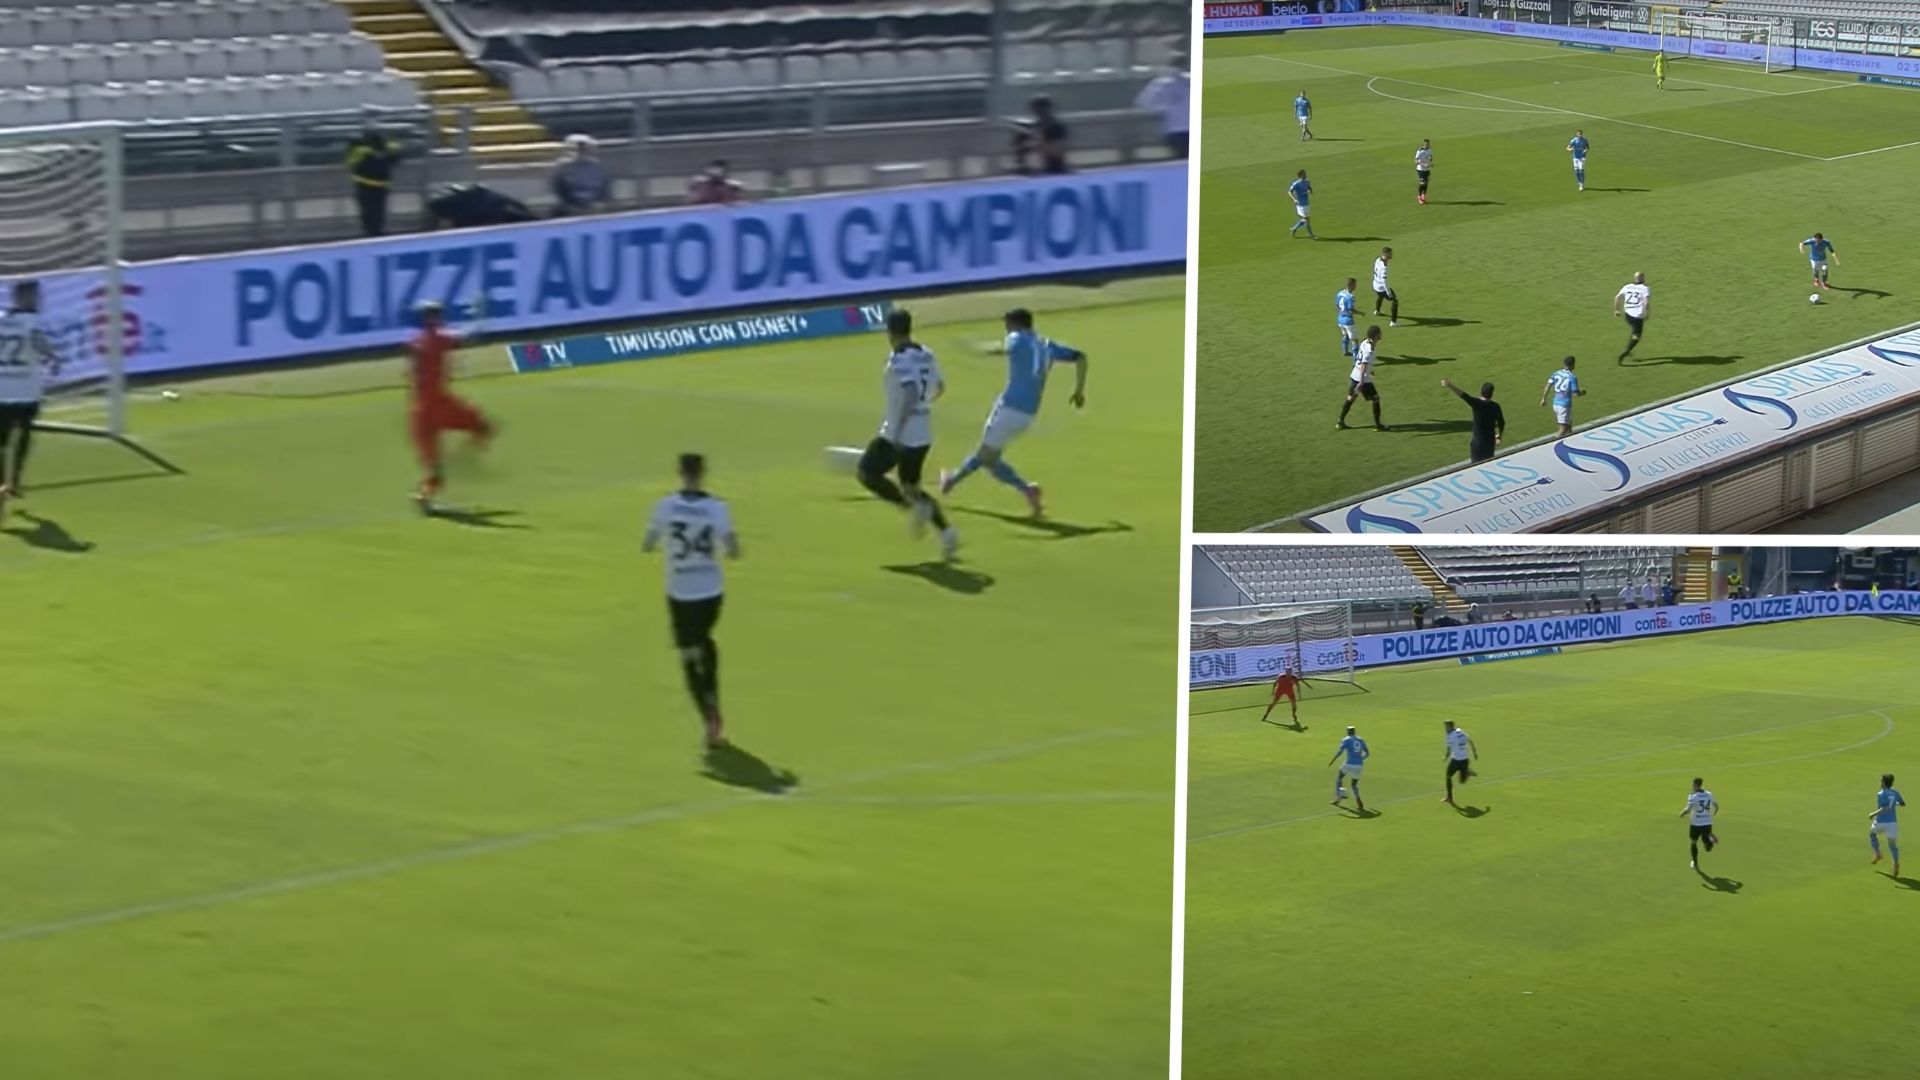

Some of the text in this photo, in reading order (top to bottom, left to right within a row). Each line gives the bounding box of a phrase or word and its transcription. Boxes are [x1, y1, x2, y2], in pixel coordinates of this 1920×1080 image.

[1210, 6, 1259, 17] HUMAN
[1516, 0, 1551, 11] Guzzoni
[1811, 21, 1836, 38] FGS
[234, 242, 517, 347] POLIZZE
[533, 220, 727, 314] AUTO
[734, 211, 818, 290] DA
[836, 181, 1150, 281] CAMPIONI
[1627, 292, 1641, 304] 23
[543, 304, 884, 363] TV TIMVISION CON DISNEY+ TV
[1554, 376, 1569, 393] 24
[1746, 358, 1863, 397] SPIGAS
[1803, 404, 1829, 419] GAS
[1829, 394, 1858, 411] LUCE
[1584, 404, 1714, 451] SPIGAS
[1684, 426, 1718, 441] CLIENTI
[1638, 431, 1751, 477] GAS LUCE SERVIZI
[1385, 459, 1539, 518] SPIGAS
[1498, 486, 1541, 506] CLIENTI
[1476, 492, 1576, 534] LUCE SERVIZI
[669, 521, 714, 560] 34
[1383, 631, 1459, 660] POLIZZE
[1462, 626, 1511, 651] AUTO
[1514, 623, 1538, 645] DA
[1541, 615, 1622, 642] CAMPIONI
[1730, 599, 1792, 622] POLIZZE
[1795, 594, 1840, 615] AUTO
[1844, 593, 1874, 612] DA
[1878, 593, 1920, 612] CAM
[1354, 740, 1361, 753] 9
[1697, 799, 1712, 814] 34
